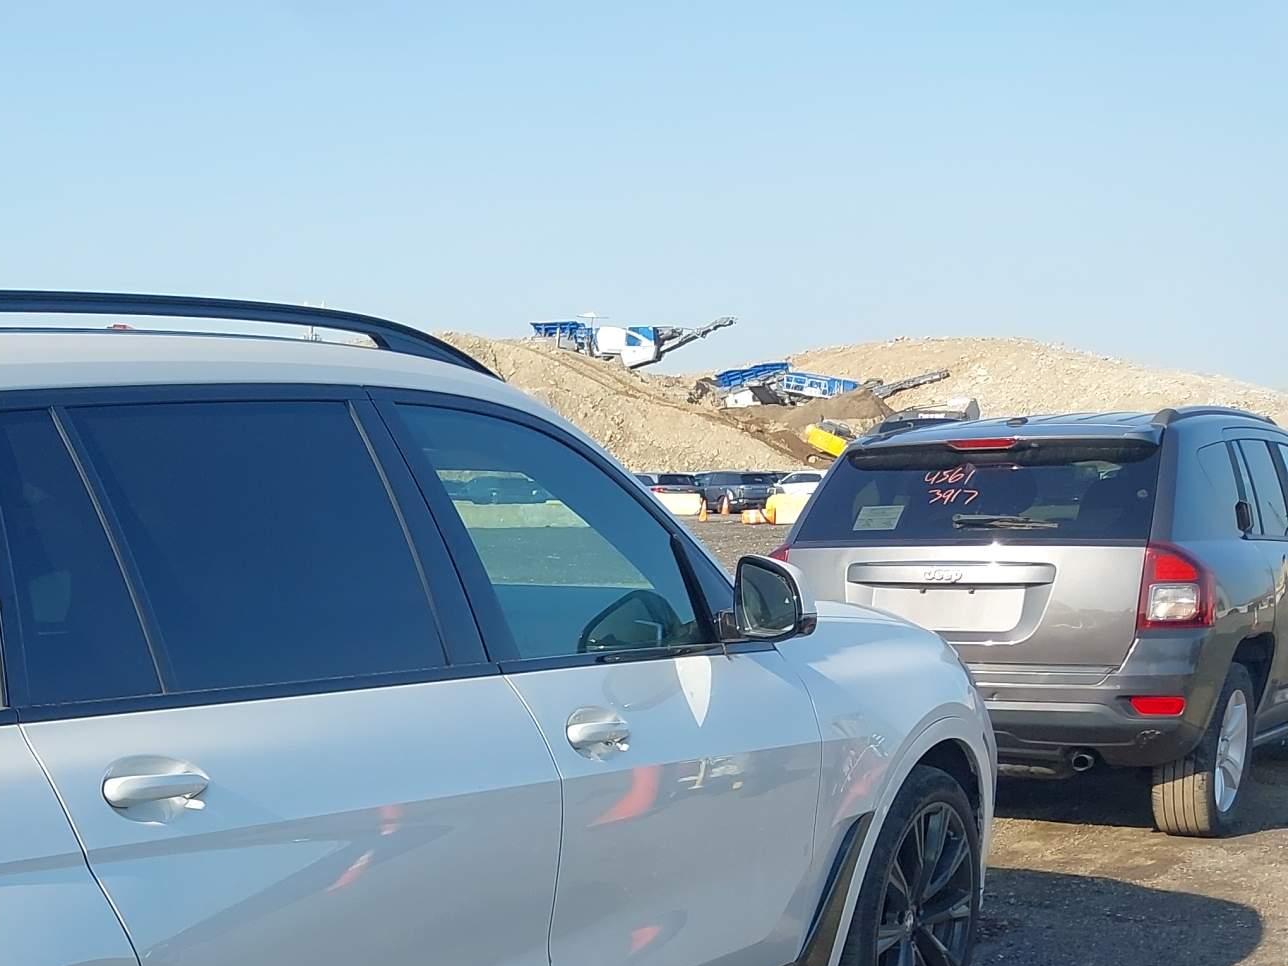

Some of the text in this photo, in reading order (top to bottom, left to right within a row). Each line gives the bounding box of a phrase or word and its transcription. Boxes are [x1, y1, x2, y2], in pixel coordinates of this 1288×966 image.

[924, 467, 976, 485] 4561
[928, 489, 978, 505] 3917
[923, 569, 963, 584] Jeep
